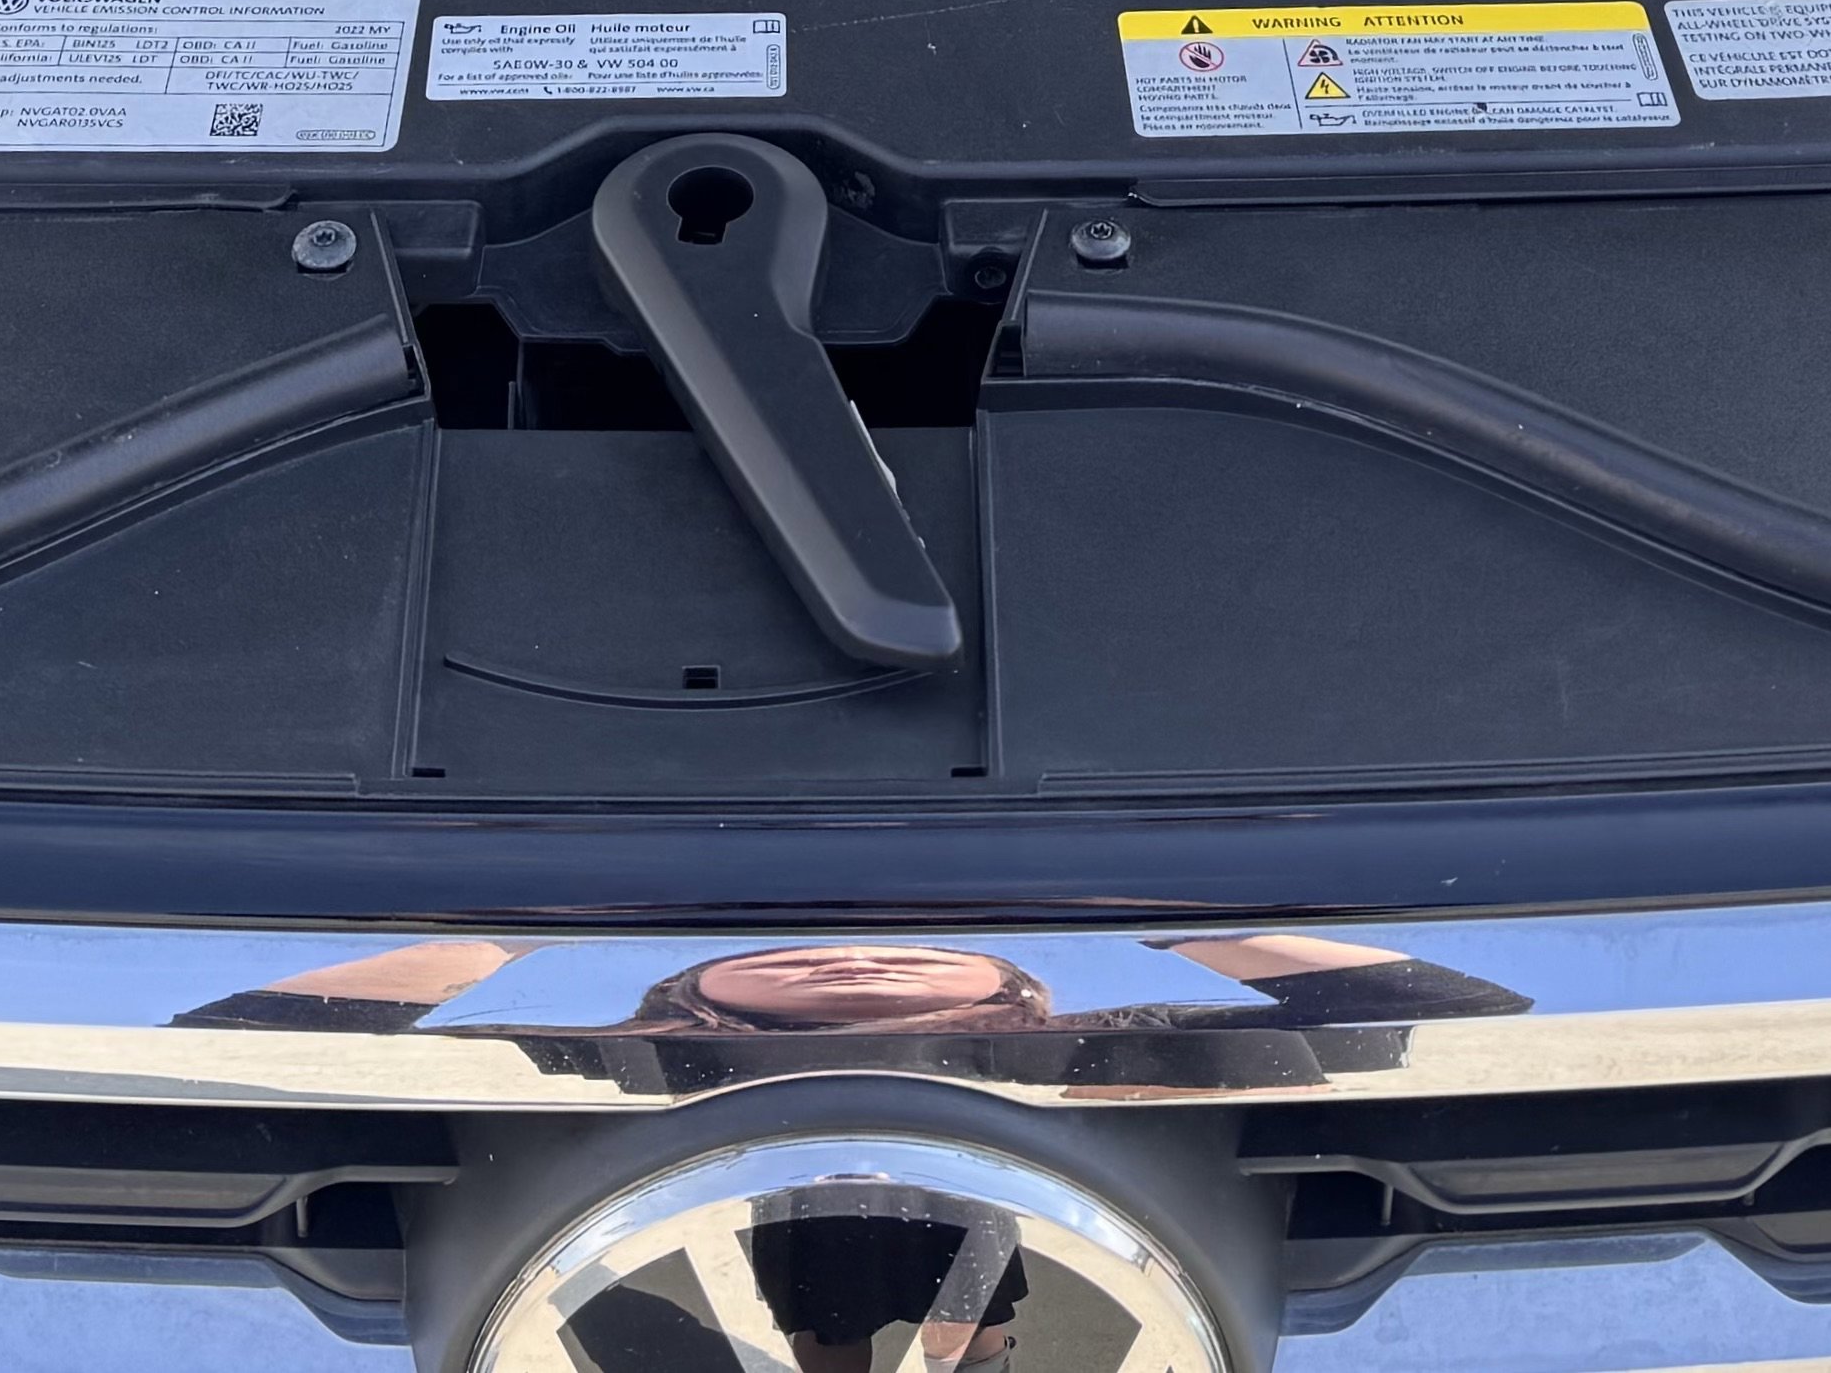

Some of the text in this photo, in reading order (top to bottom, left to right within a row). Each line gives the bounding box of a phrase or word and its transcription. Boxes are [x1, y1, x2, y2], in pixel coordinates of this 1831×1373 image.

[34, 5, 325, 15] VEHICLE EMISSION CONTROL INFORMATION
[1673, 9, 1704, 17] THIS
[1253, 15, 1463, 29] WARNING ATTENTION
[1678, 19, 1753, 30] ALL-WHEEL
[61, 24, 74, 32] to
[79, 25, 157, 34] regulations:
[335, 26, 364, 34] 2022
[501, 24, 576, 36] Engine Oil
[591, 24, 690, 33] Huile moteur
[1682, 31, 1741, 42] TESTING
[1745, 31, 1766, 41] ON
[16, 40, 45, 48] EPA:
[73, 40, 115, 48] BIN125
[133, 55, 157, 63] LDT
[290, 56, 320, 64] Fuel:
[329, 56, 385, 64] Gasoline
[1690, 54, 1706, 63] CE
[1780, 51, 1803, 60] EST
[577, 60, 588, 68] &
[597, 60, 622, 68] VW
[628, 60, 654, 68] 504
[660, 59, 678, 68] 00
[0, 74, 85, 84] adjustments
[89, 74, 142, 83] needed.
[1699, 79, 1728, 89] SUR
